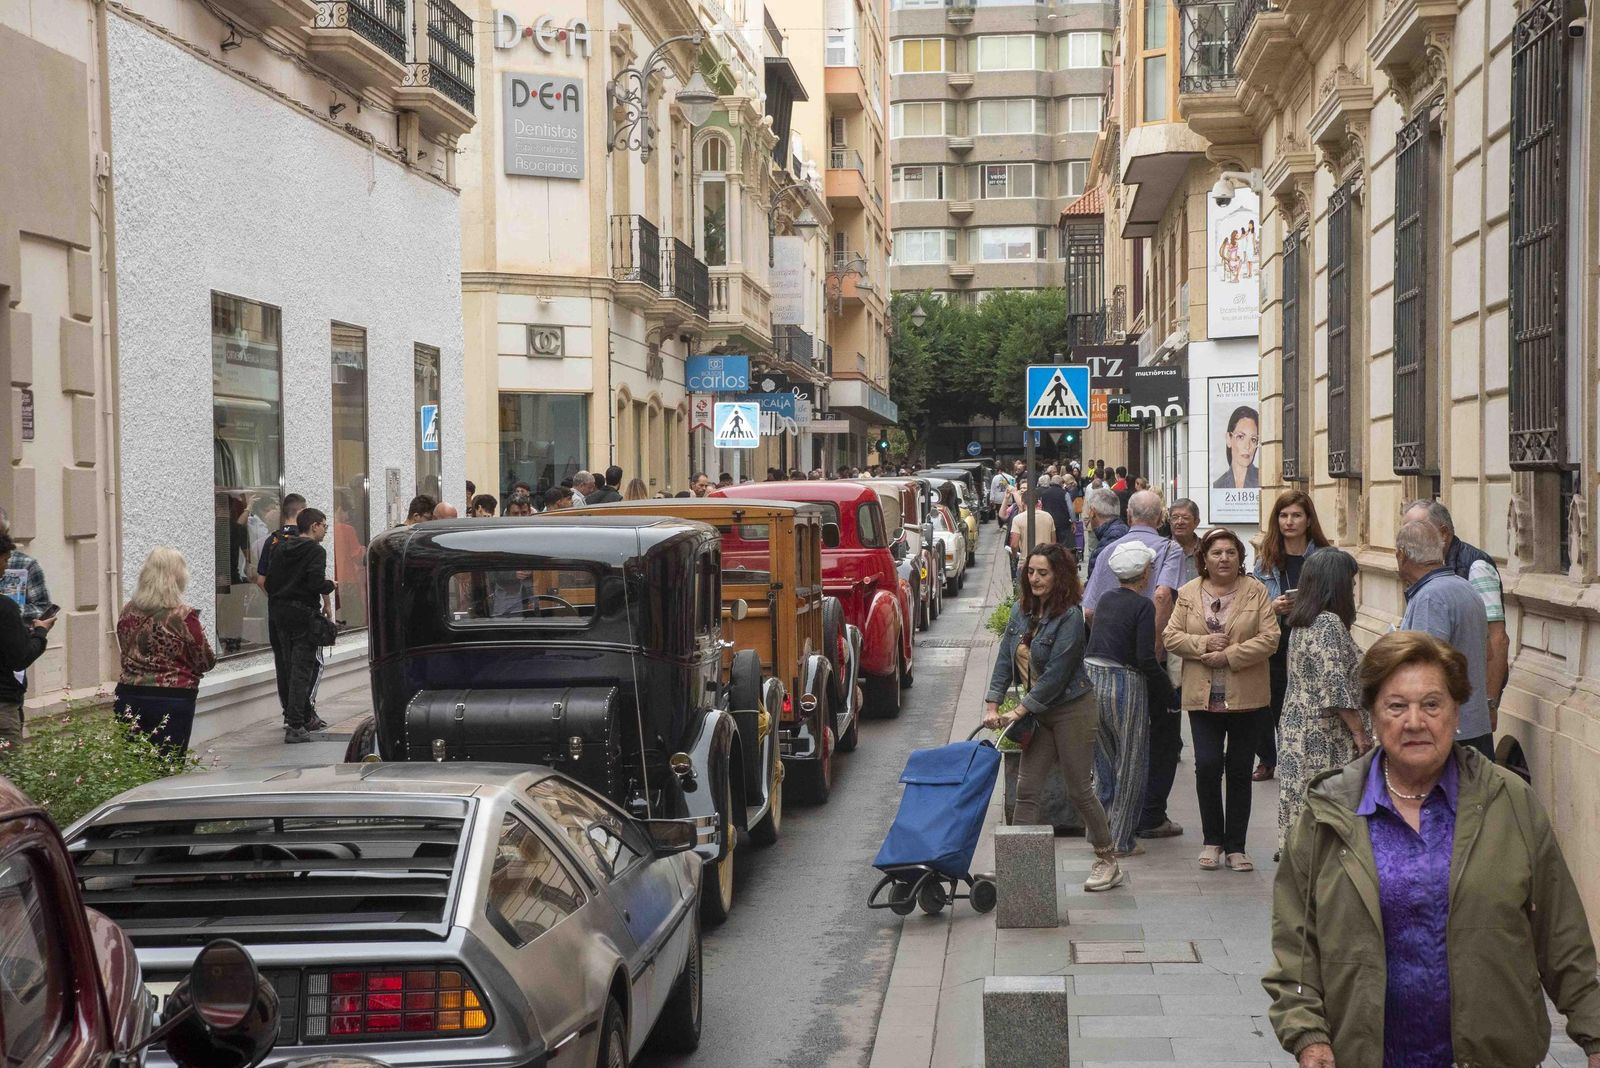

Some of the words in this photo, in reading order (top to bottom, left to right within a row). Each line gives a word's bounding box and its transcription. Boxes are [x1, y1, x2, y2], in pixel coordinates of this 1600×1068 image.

[514, 119, 578, 140] Dentistas
[515, 156, 578, 174] Asociados
[1086, 356, 1123, 378] TZ
[689, 371, 746, 389] carlos
[1216, 382, 1246, 393] VERTE
